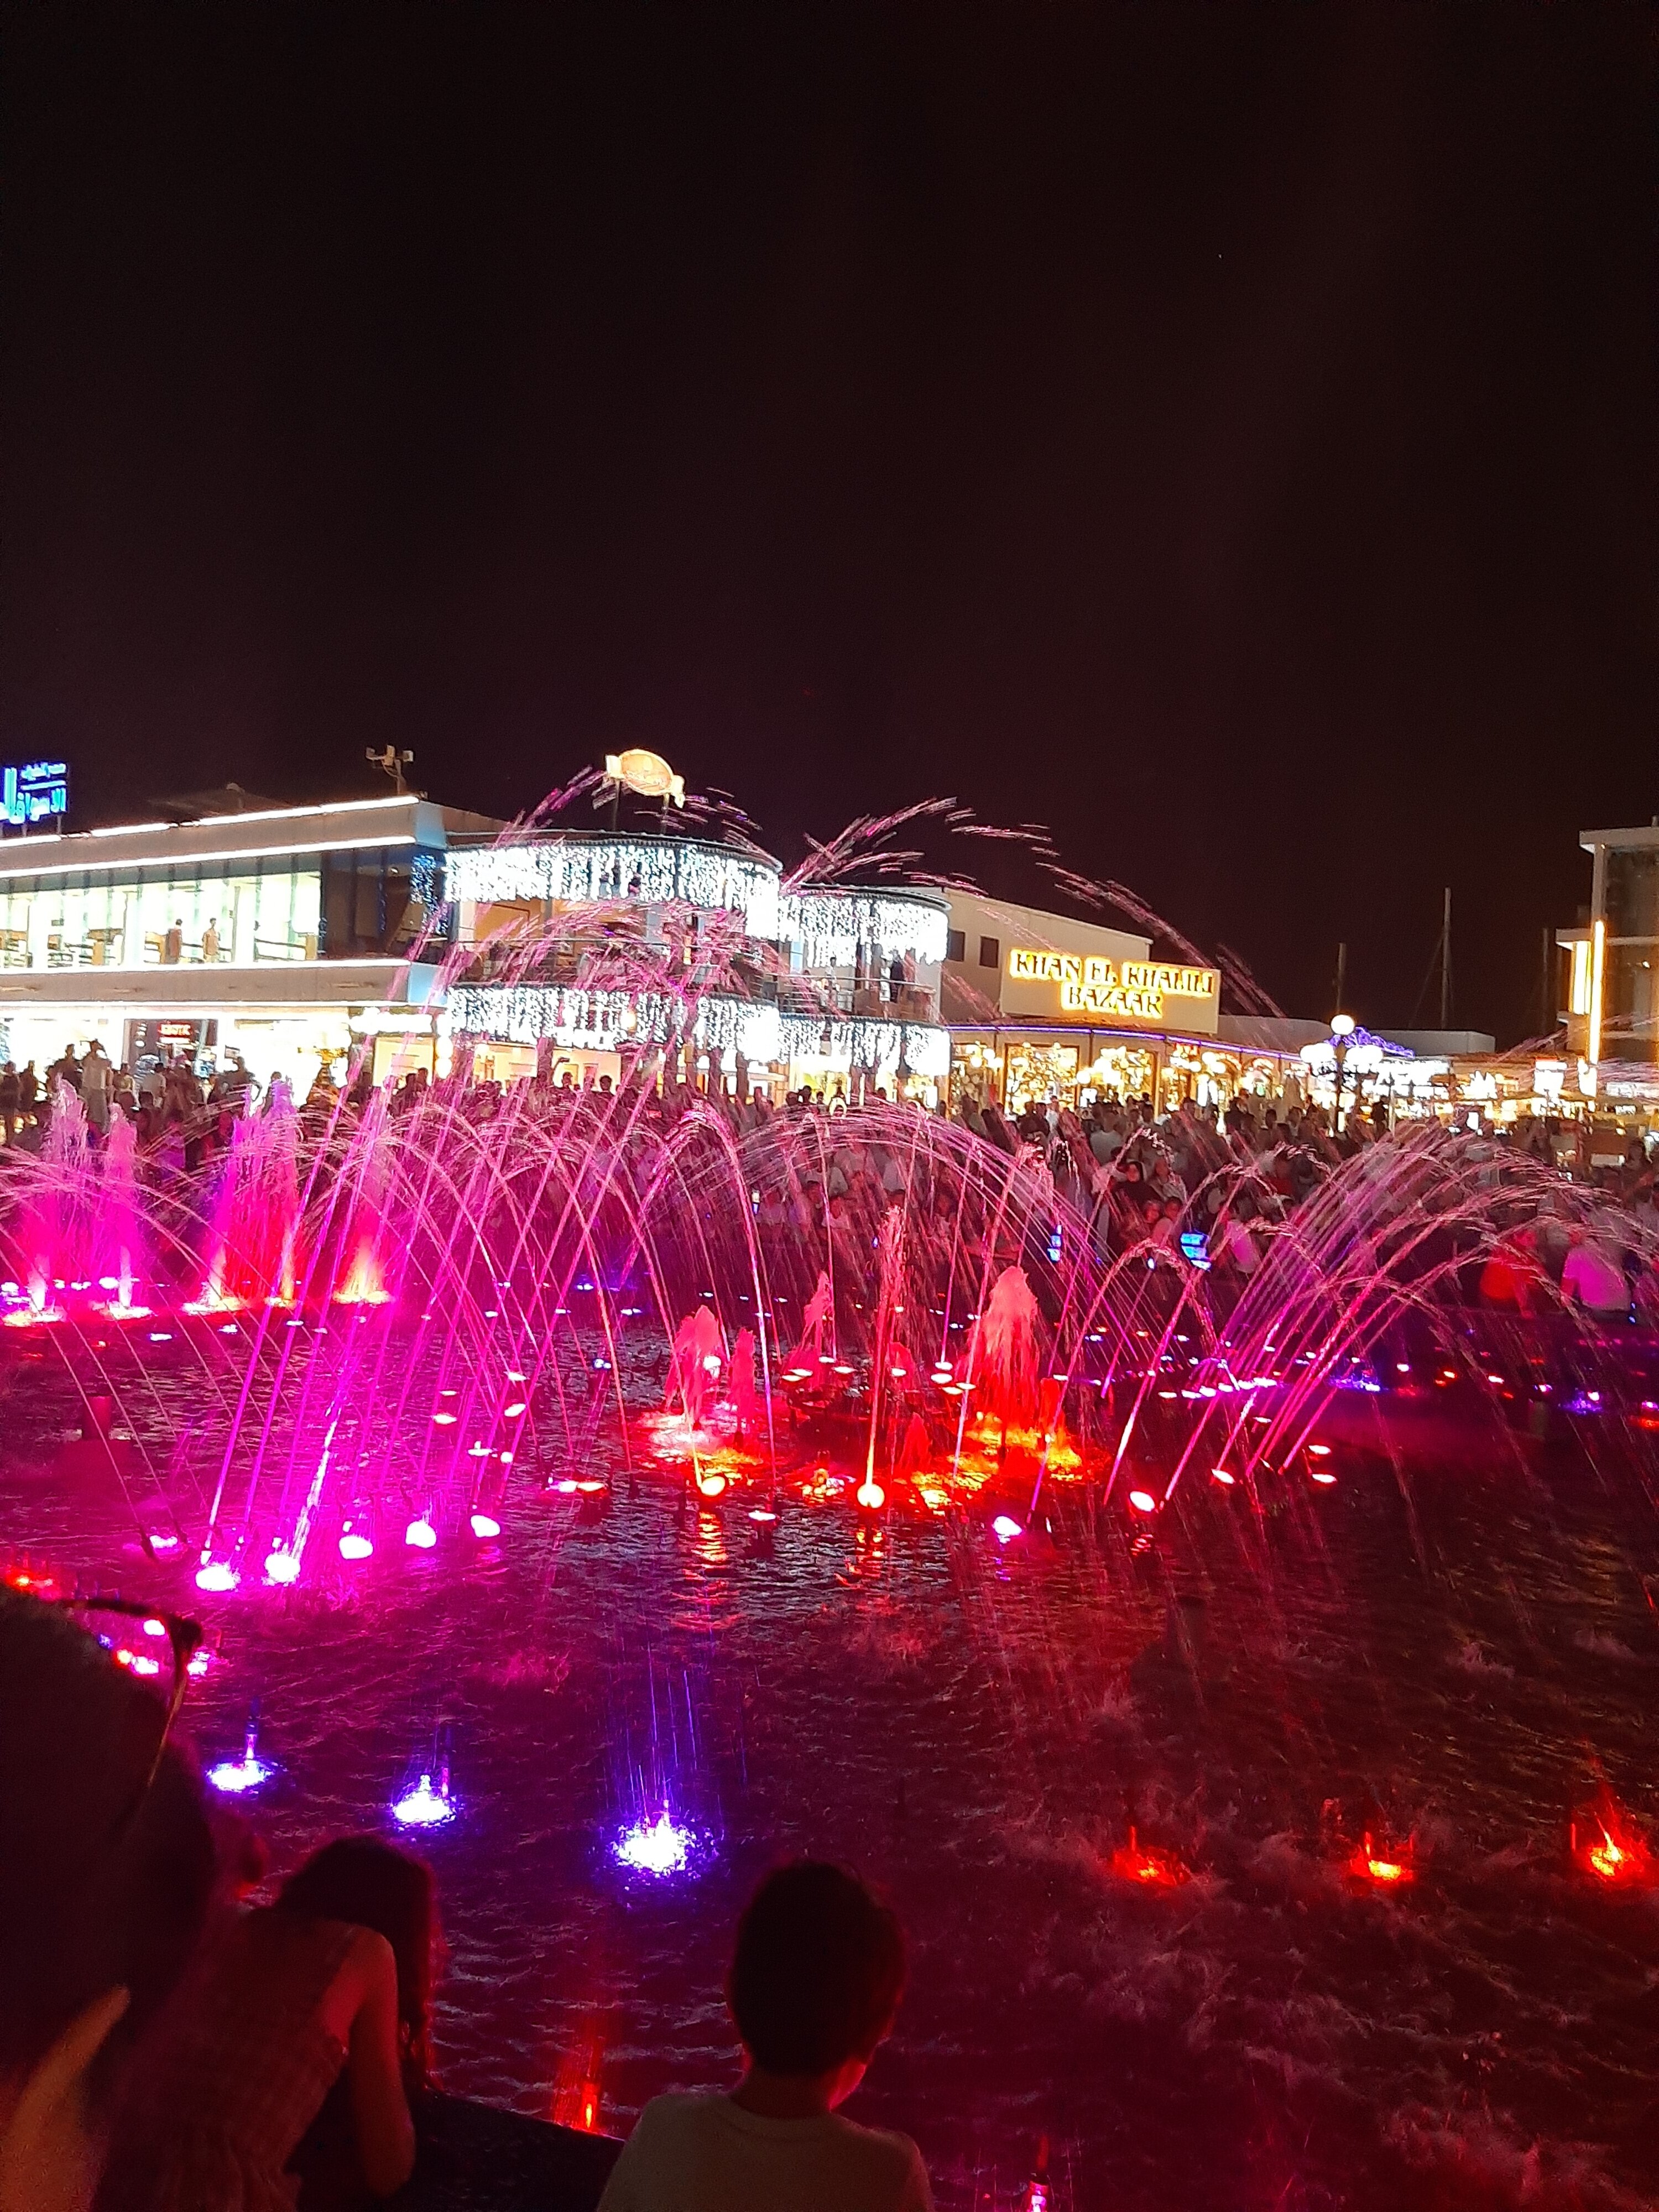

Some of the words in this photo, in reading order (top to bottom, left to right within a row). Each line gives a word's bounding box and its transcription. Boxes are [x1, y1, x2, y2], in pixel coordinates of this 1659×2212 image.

[1013, 951, 1081, 980] KHAN
[1088, 960, 1117, 984] EL
[1125, 964, 1213, 995] KHALILI
[1065, 984, 1161, 1017] BAZAAR
